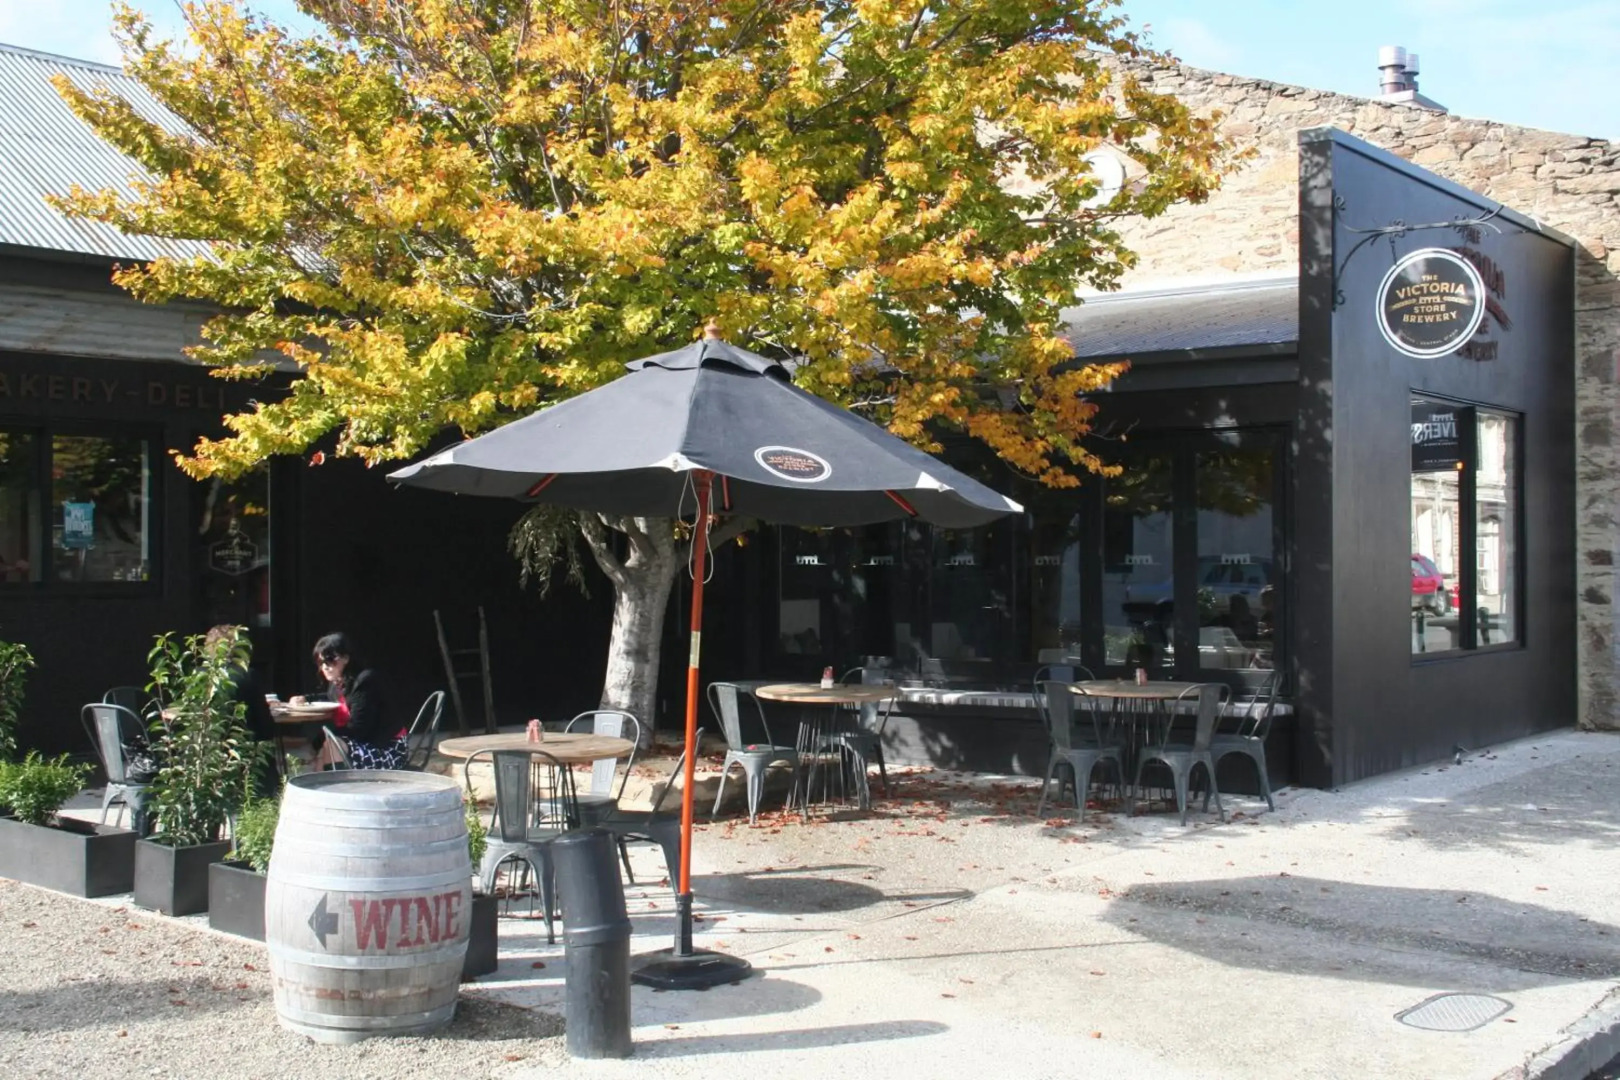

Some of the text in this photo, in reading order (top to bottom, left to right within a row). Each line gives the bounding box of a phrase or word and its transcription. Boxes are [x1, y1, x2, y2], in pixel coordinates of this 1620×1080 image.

[1396, 282, 1465, 299] VICTORIA
[1413, 304, 1446, 314] STORE
[1402, 311, 1457, 323] BREWERY
[349, 890, 462, 950] WINE
